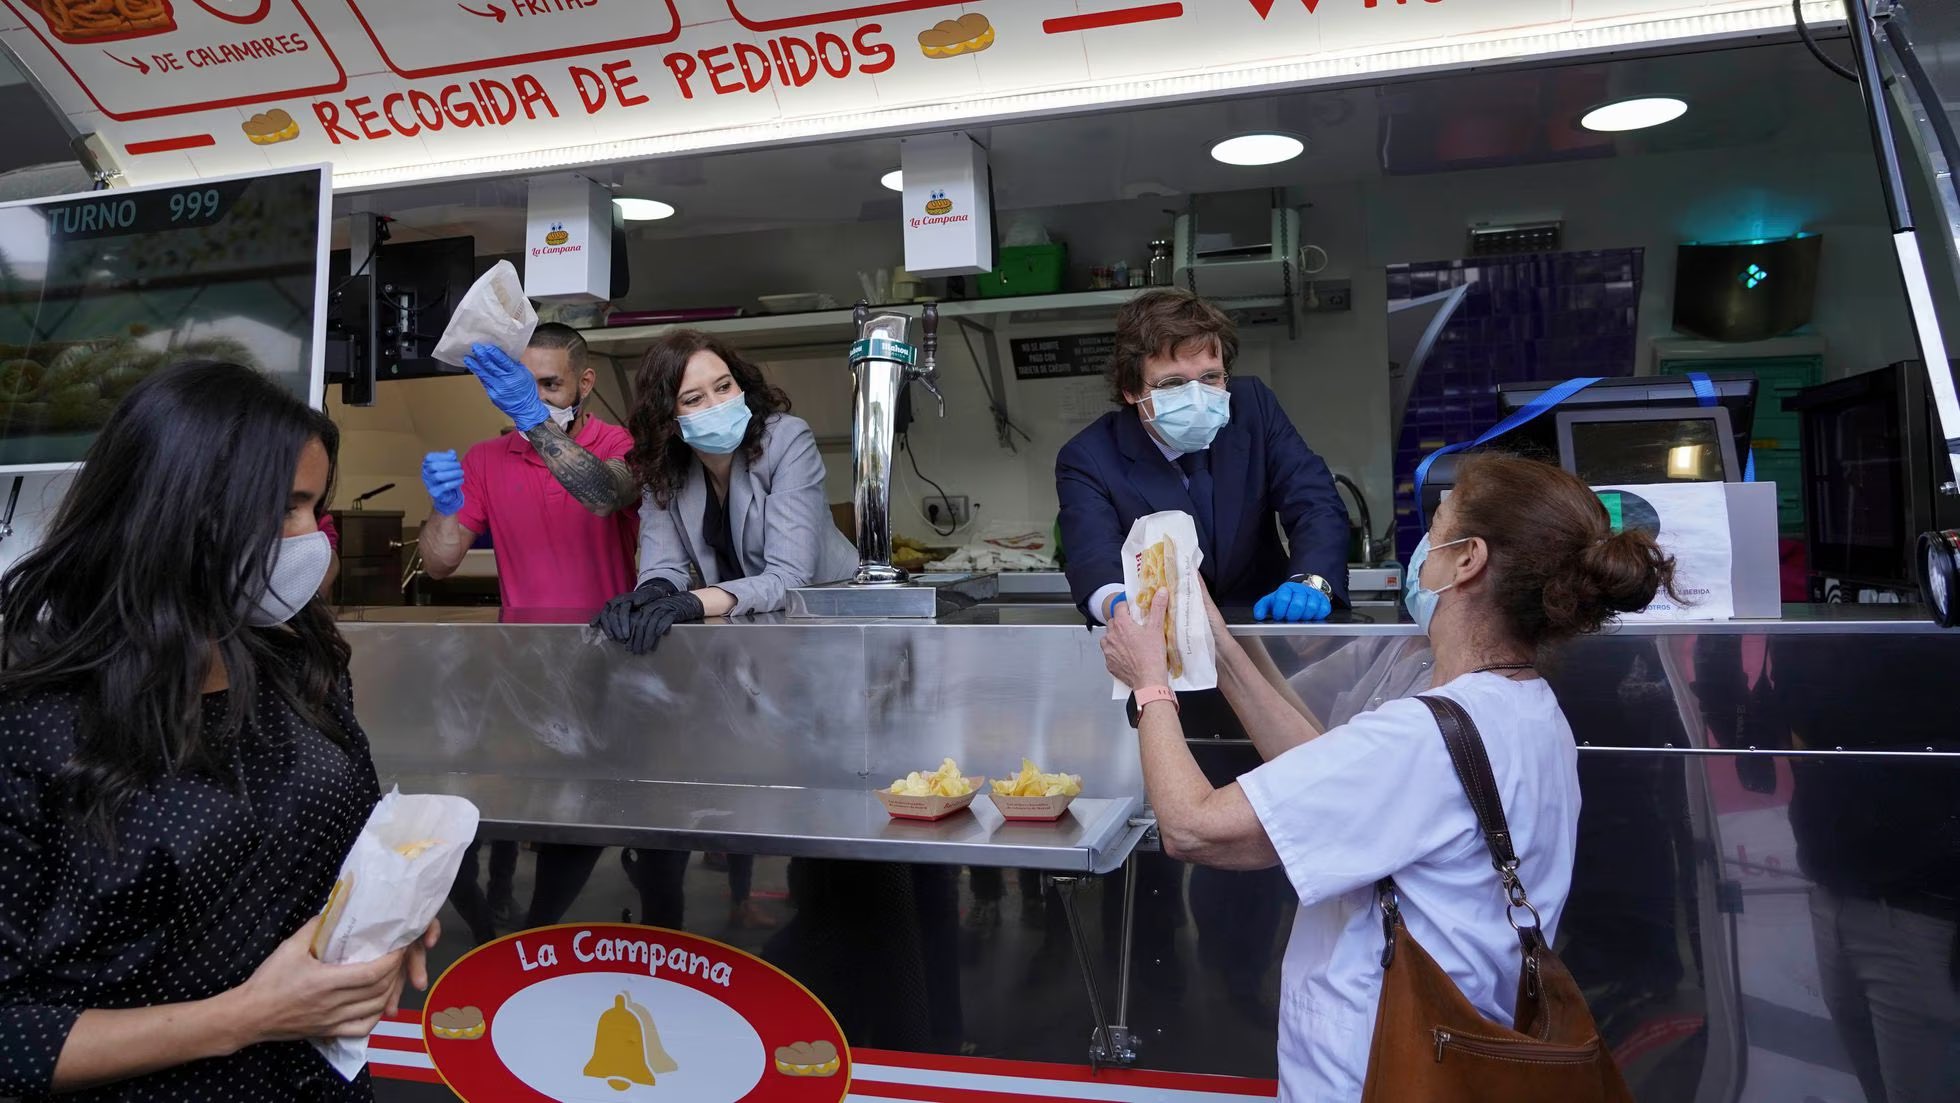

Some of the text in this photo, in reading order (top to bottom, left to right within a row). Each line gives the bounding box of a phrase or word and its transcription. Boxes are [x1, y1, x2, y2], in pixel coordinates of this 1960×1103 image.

[151, 33, 309, 73] DE CALAMARES
[311, 22, 896, 145] RECOGIDA DE PEDIDOS
[48, 189, 220, 235] TURNO 999
[910, 214, 969, 228] La Campana
[532, 245, 581, 257] La Campana
[515, 930, 733, 987] La Campana
